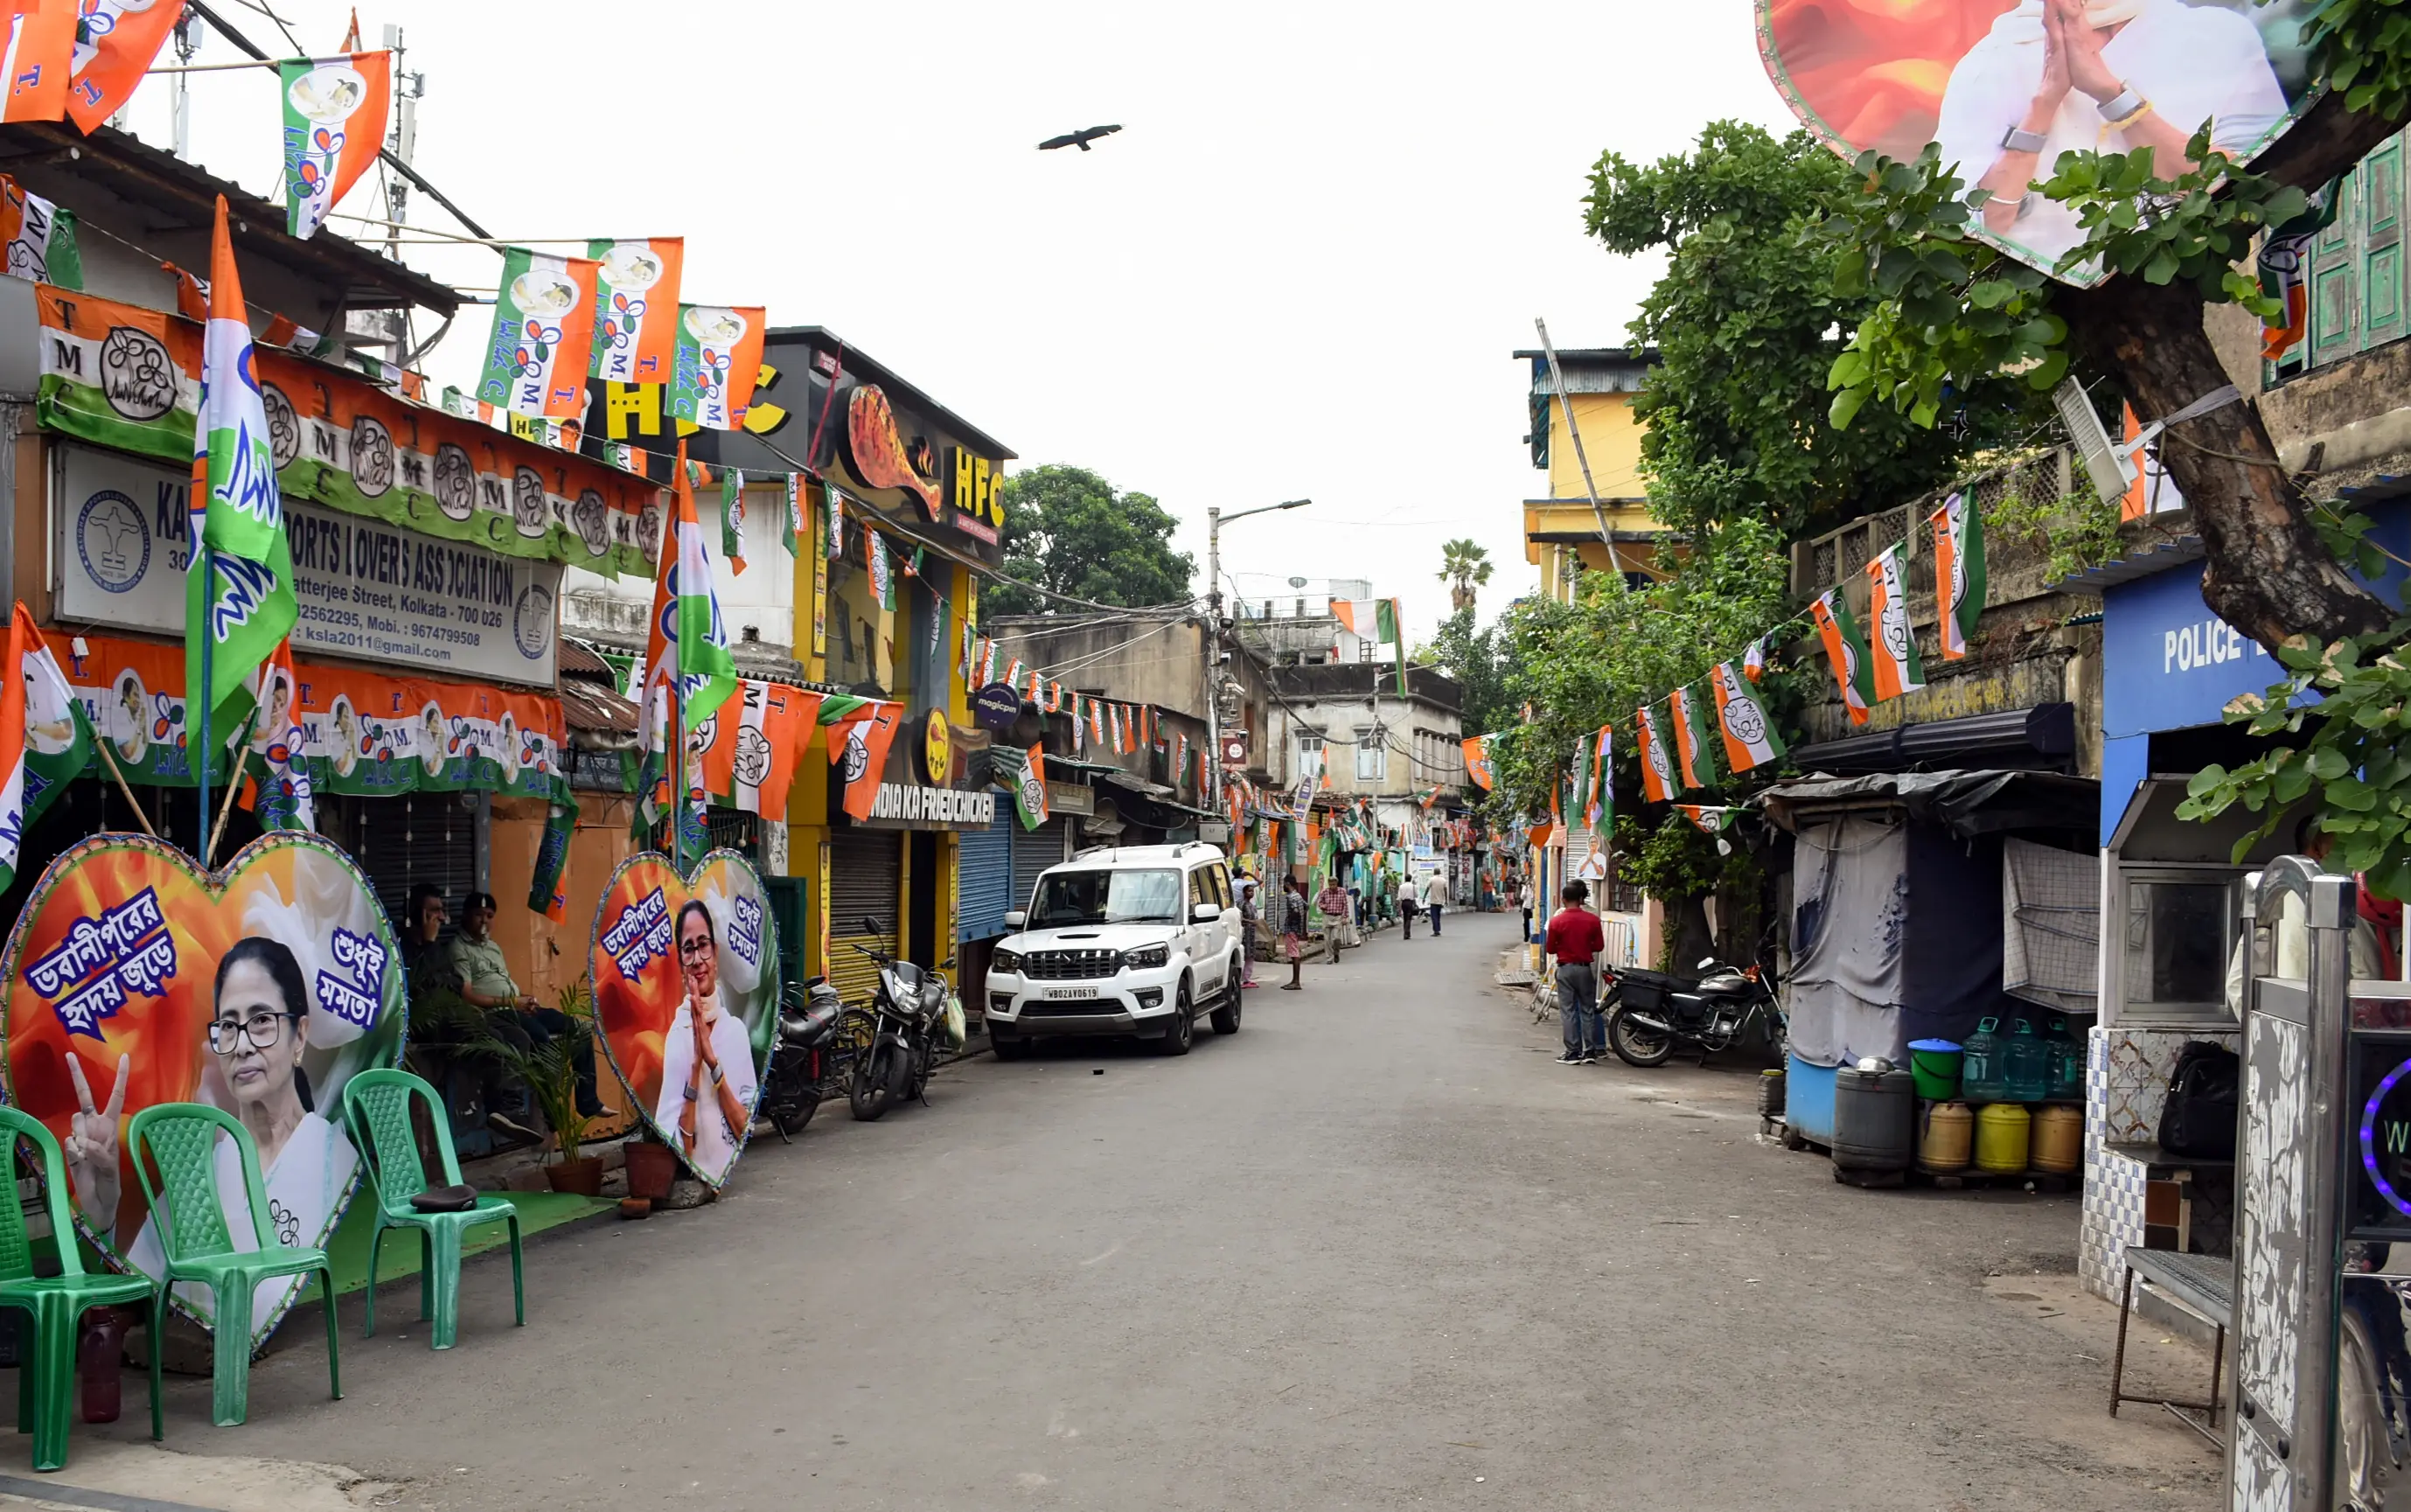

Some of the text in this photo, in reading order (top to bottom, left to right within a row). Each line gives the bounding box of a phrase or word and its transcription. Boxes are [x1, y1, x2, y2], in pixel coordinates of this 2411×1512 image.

[15, 65, 41, 95] T.
[74, 77, 104, 107] T.
[55, 298, 76, 331] T
[54, 339, 82, 376] M
[610, 352, 629, 379] M.
[639, 355, 658, 375] T.
[483, 378, 576, 409] C. M. T.
[673, 397, 692, 415] C.
[707, 404, 722, 427] M.
[312, 424, 338, 463] M
[317, 468, 333, 495] C
[483, 480, 507, 510] M
[956, 446, 1005, 527] HFC
[408, 492, 421, 520] C
[488, 516, 505, 542] C
[345, 525, 410, 588] LOVERS
[294, 576, 348, 603] atterjee
[352, 585, 396, 613] Street,
[401, 595, 447, 618] Kolkata
[458, 605, 478, 624] 700
[482, 611, 502, 628] 026
[306, 626, 451, 660] ksla2011@gmail.com
[367, 616, 401, 634] Mobi.
[411, 624, 480, 646] 9674799508
[2164, 617, 2241, 673] POLICE
[299, 683, 314, 705] T.
[743, 686, 786, 714] M T
[978, 698, 1016, 714] magicpin
[303, 722, 322, 744] M.
[875, 714, 892, 730] T
[394, 728, 412, 748] M.
[870, 783, 902, 819] NDIA
[902, 785, 921, 819] KA
[603, 890, 665, 951] ভবানীপুরের
[30, 893, 159, 993] ভবানীপুরের
[729, 926, 757, 962] মমতা
[335, 933, 385, 986] শুধুই
[60, 936, 173, 1029] হৃদয় জুড়ে
[320, 975, 378, 1026] মমতা
